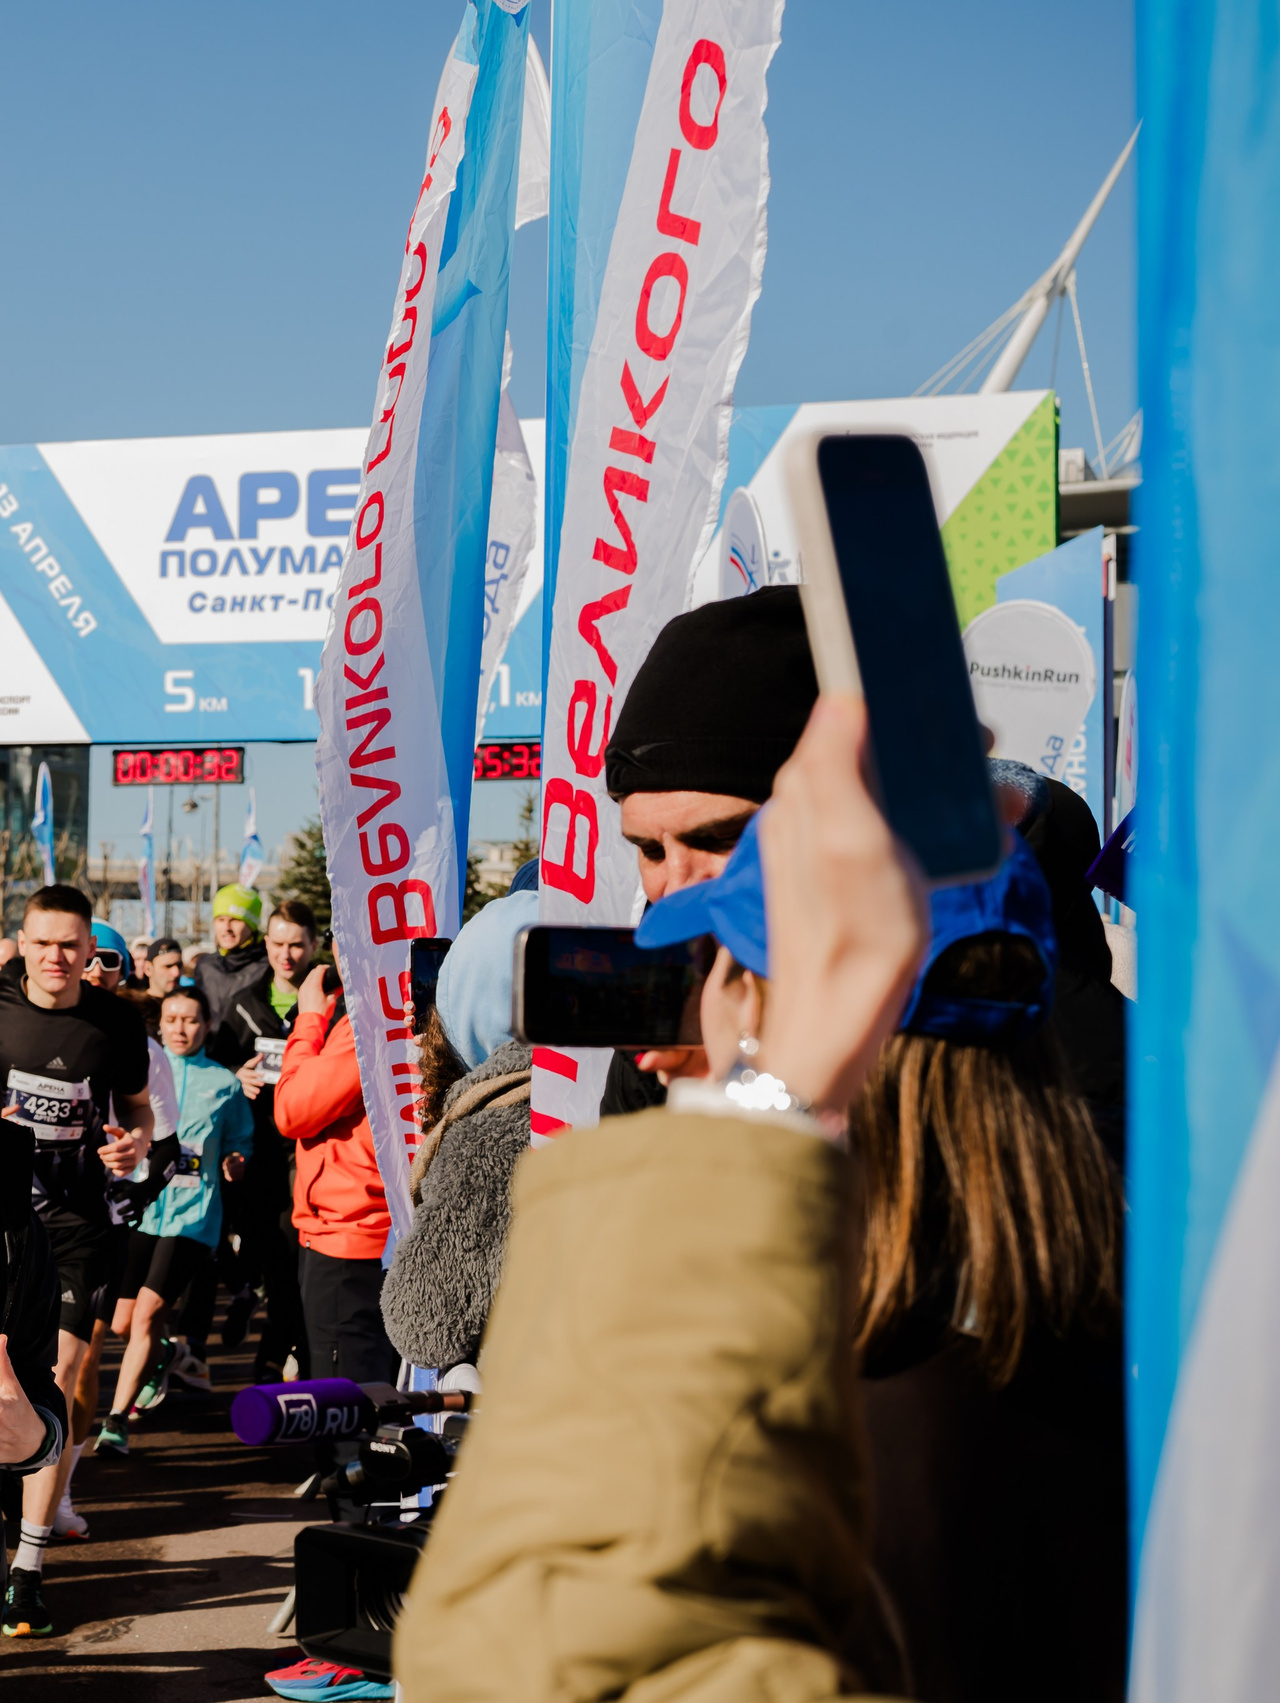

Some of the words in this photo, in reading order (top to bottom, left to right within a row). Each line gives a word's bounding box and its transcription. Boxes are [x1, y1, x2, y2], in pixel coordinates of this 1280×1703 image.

[542, 38, 727, 904] Великого
[163, 468, 362, 543] АРЕ
[10, 521, 98, 638] АПРЕЛЯ
[160, 545, 344, 578] ПОЛУМА
[164, 670, 195, 713] 5
[298, 667, 316, 711] 1
[970, 661, 1080, 685] PushkinRun
[116, 750, 239, 784] 00:00:32
[23, 1096, 72, 1118] 4233
